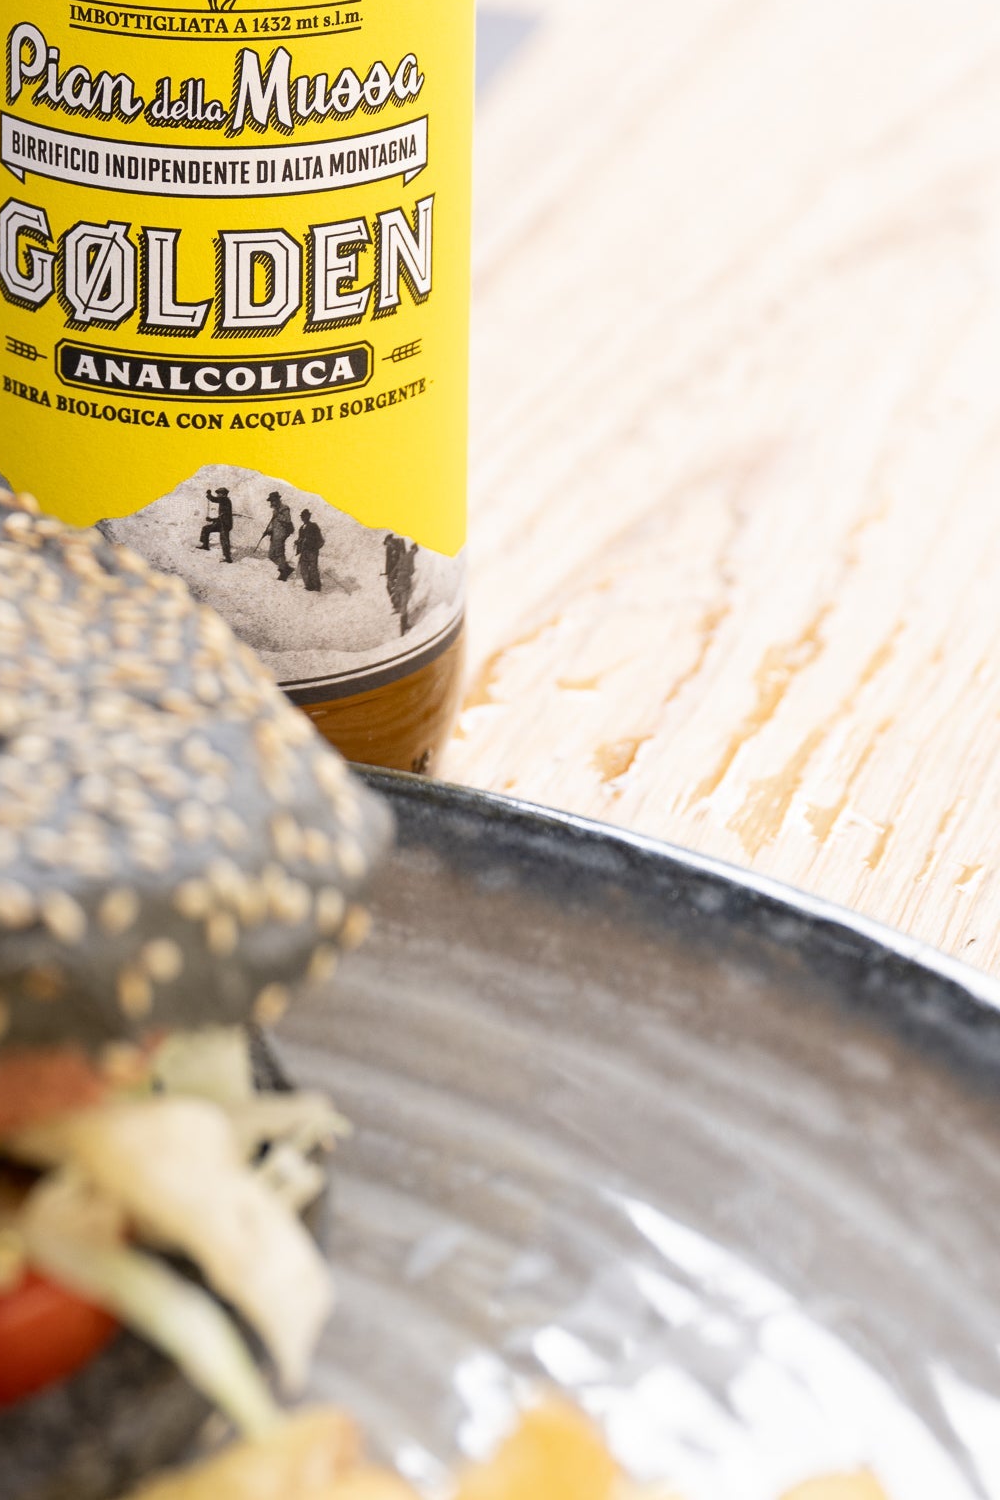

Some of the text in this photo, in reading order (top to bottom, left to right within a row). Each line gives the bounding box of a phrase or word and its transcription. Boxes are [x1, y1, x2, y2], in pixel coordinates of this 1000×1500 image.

[69, 4, 364, 34] IMBOTTIGLIATA A 1432 mt s.l.m.
[6, 21, 425, 138] Pian della Mussa
[12, 130, 417, 185] BIRRIFICIO INDIPENDENTE DI ALTA MONTAGNA
[73, 354, 356, 392] ANALCOLICA
[3, 376, 426, 431] BIRRA BIOLOGICA CON ACQUA DI SORGENTE
